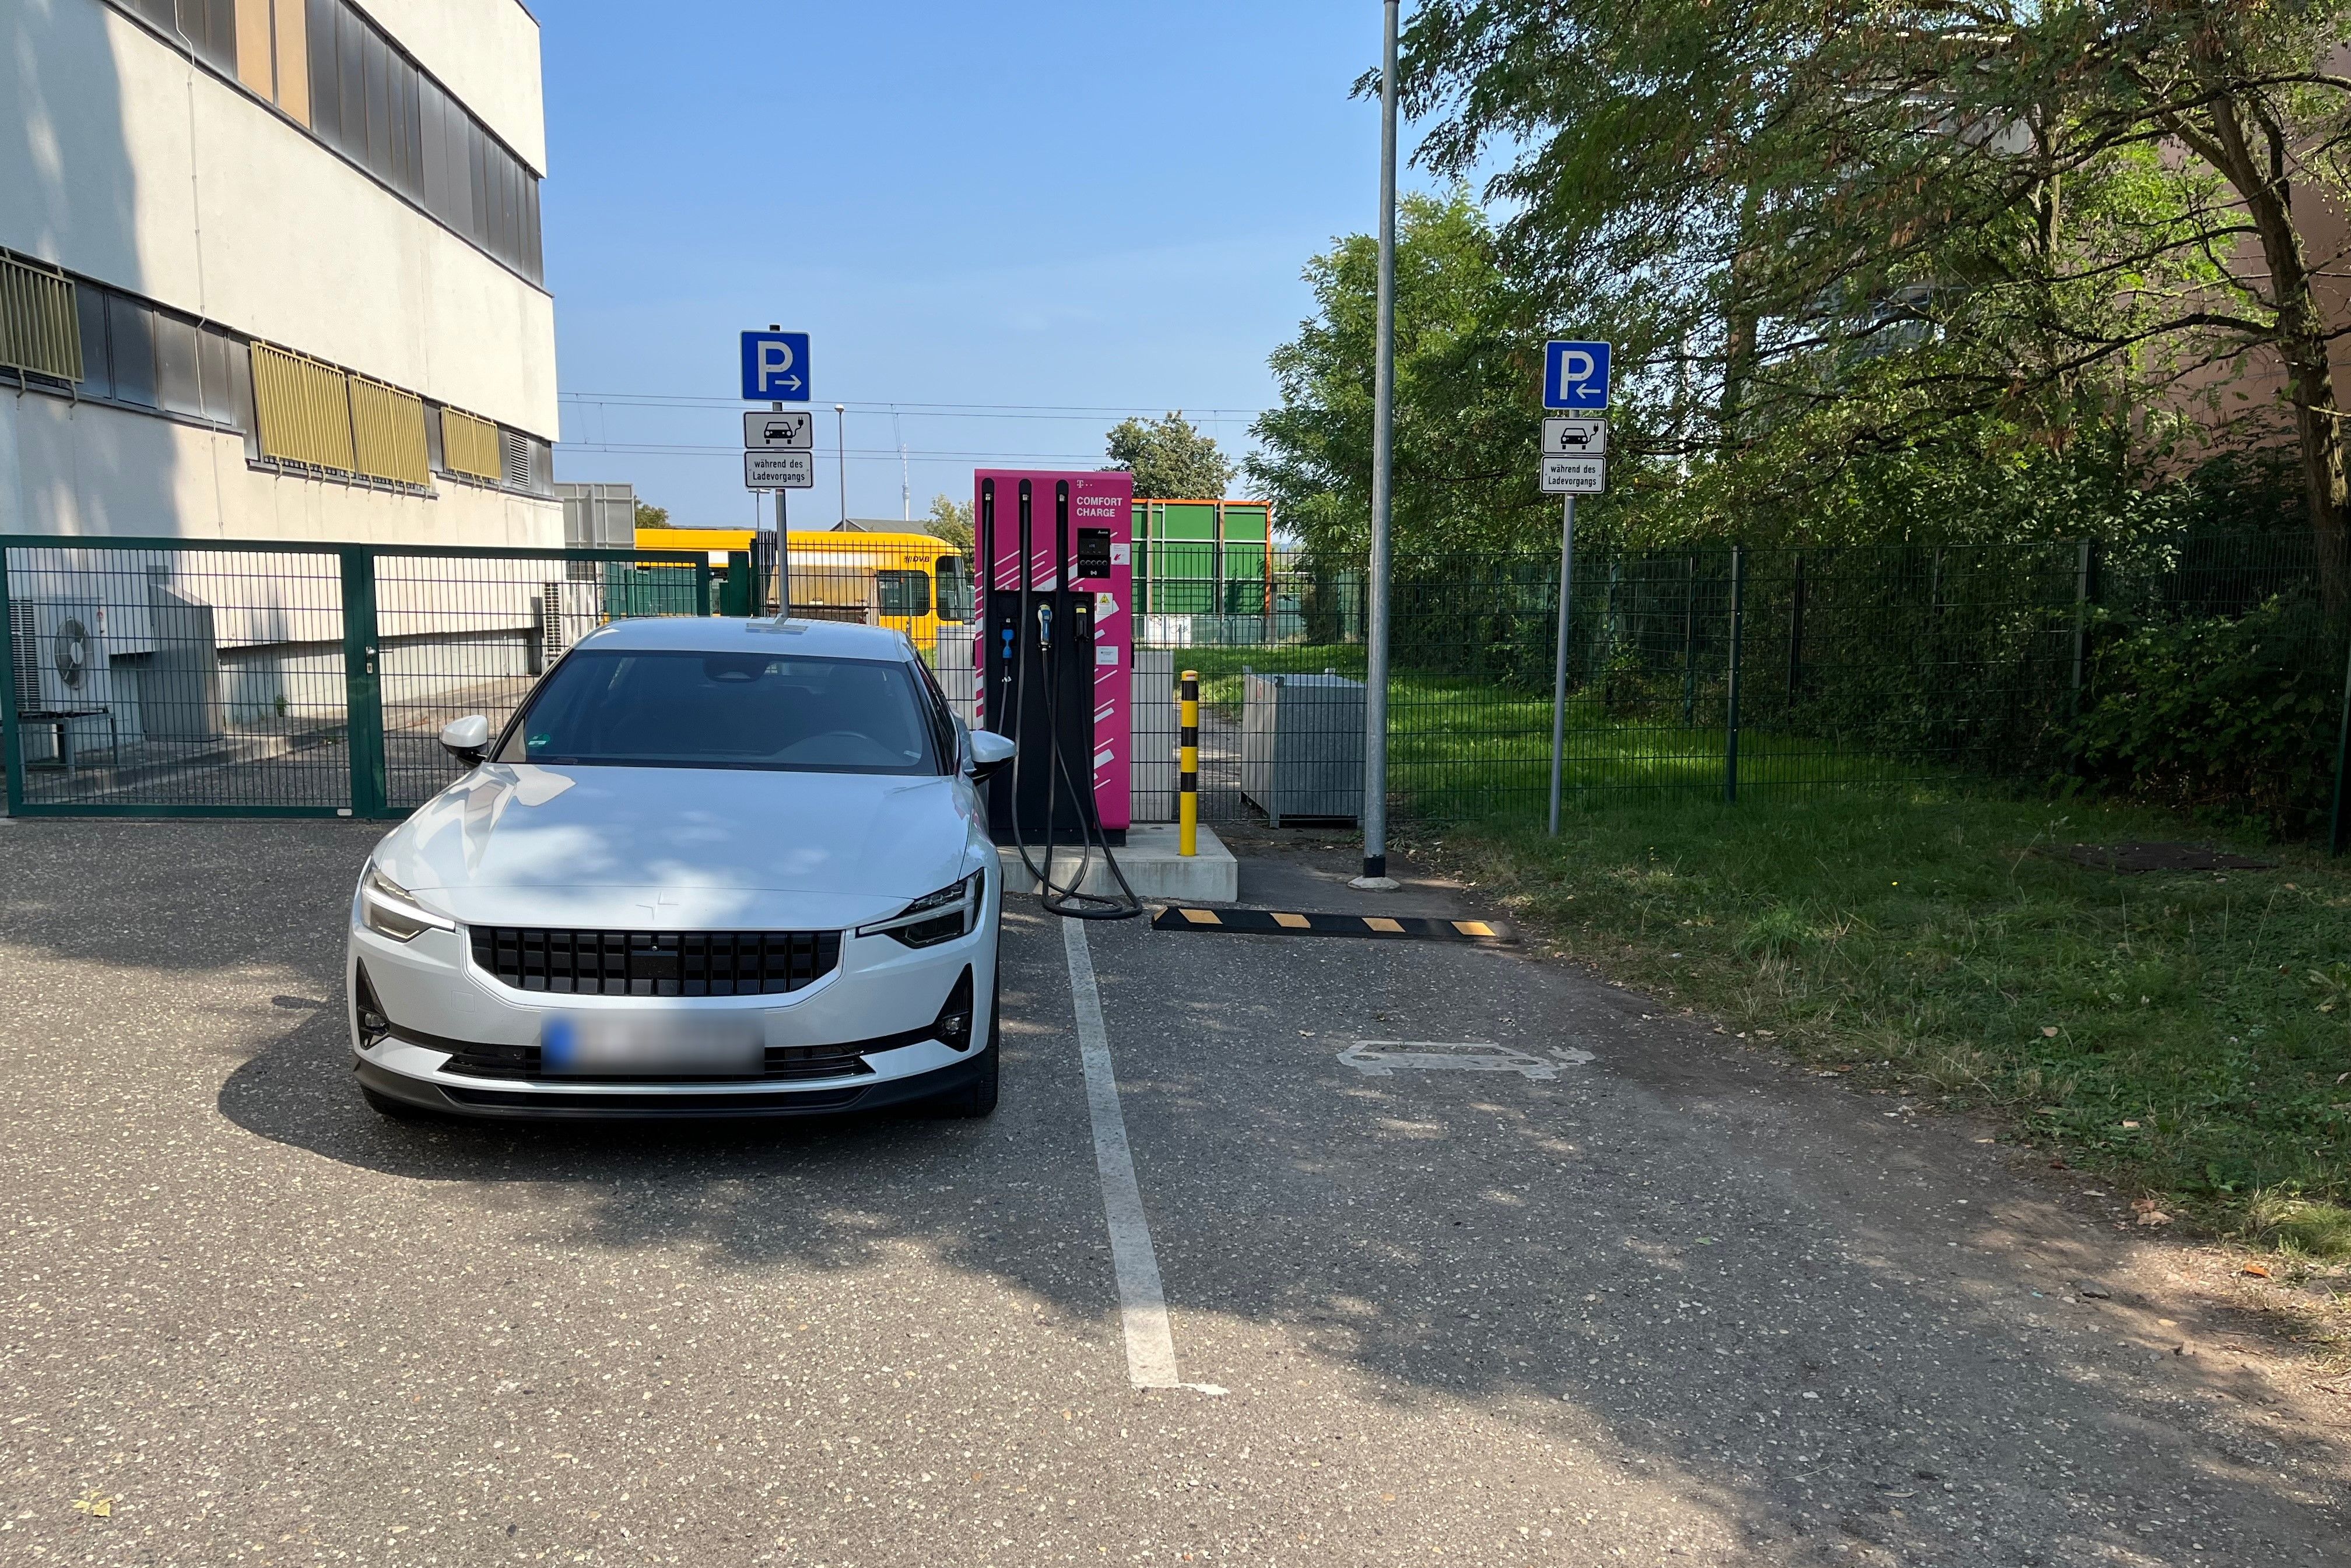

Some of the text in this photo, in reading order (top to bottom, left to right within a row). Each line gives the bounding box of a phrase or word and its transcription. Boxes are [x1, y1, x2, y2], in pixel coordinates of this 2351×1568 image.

[757, 340, 793, 392] P
[1560, 350, 1594, 400] P
[754, 459, 803, 468] während des
[1550, 464, 1596, 473] während des
[753, 472, 805, 482] Ladevorgangs
[1548, 476, 1596, 487] Ladevorgangs
[1076, 497, 1122, 506] COMFORT
[1076, 508, 1115, 517] CHARGE
